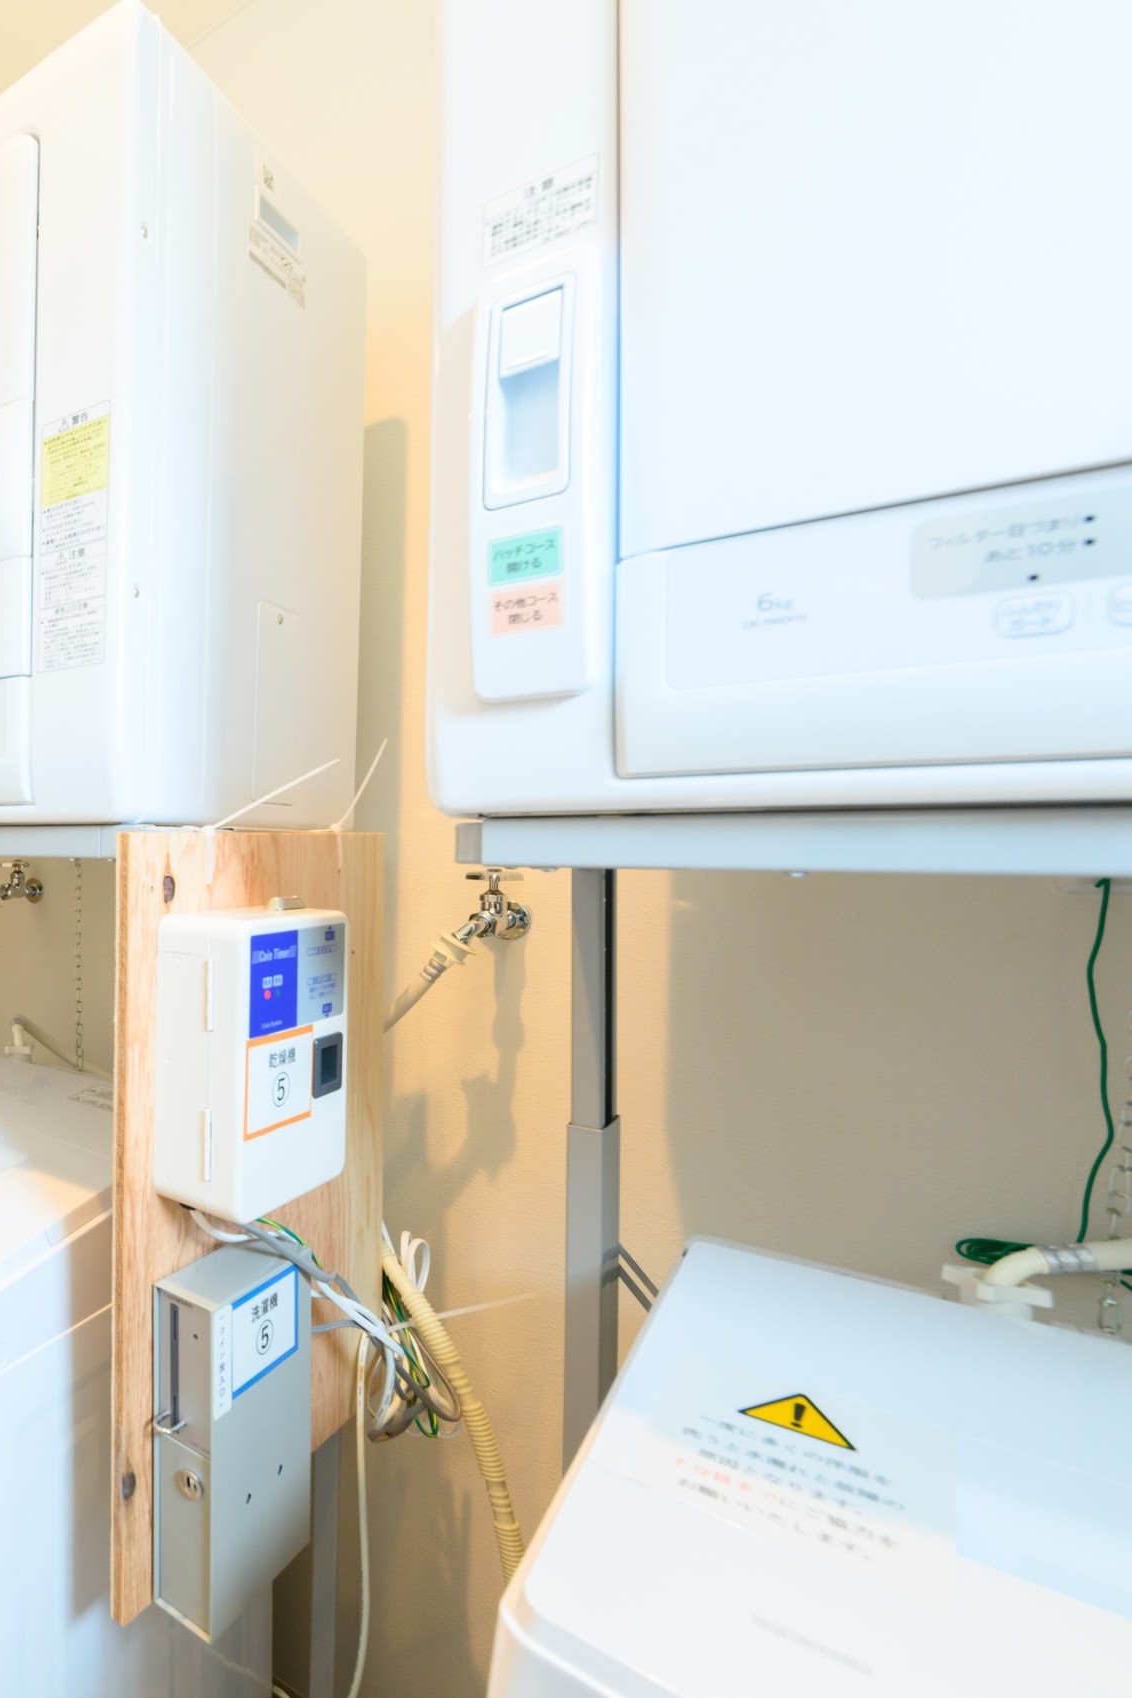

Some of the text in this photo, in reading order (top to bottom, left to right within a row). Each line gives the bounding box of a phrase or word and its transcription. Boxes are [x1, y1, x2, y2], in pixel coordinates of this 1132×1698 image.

[494, 538, 556, 561] ハッチコース
[494, 591, 558, 612] その他コース
[268, 1046, 296, 1070] 乾燥機
[251, 1292, 278, 1323] 洗濯機
[676, 1477, 873, 1562] お願いいたします。
